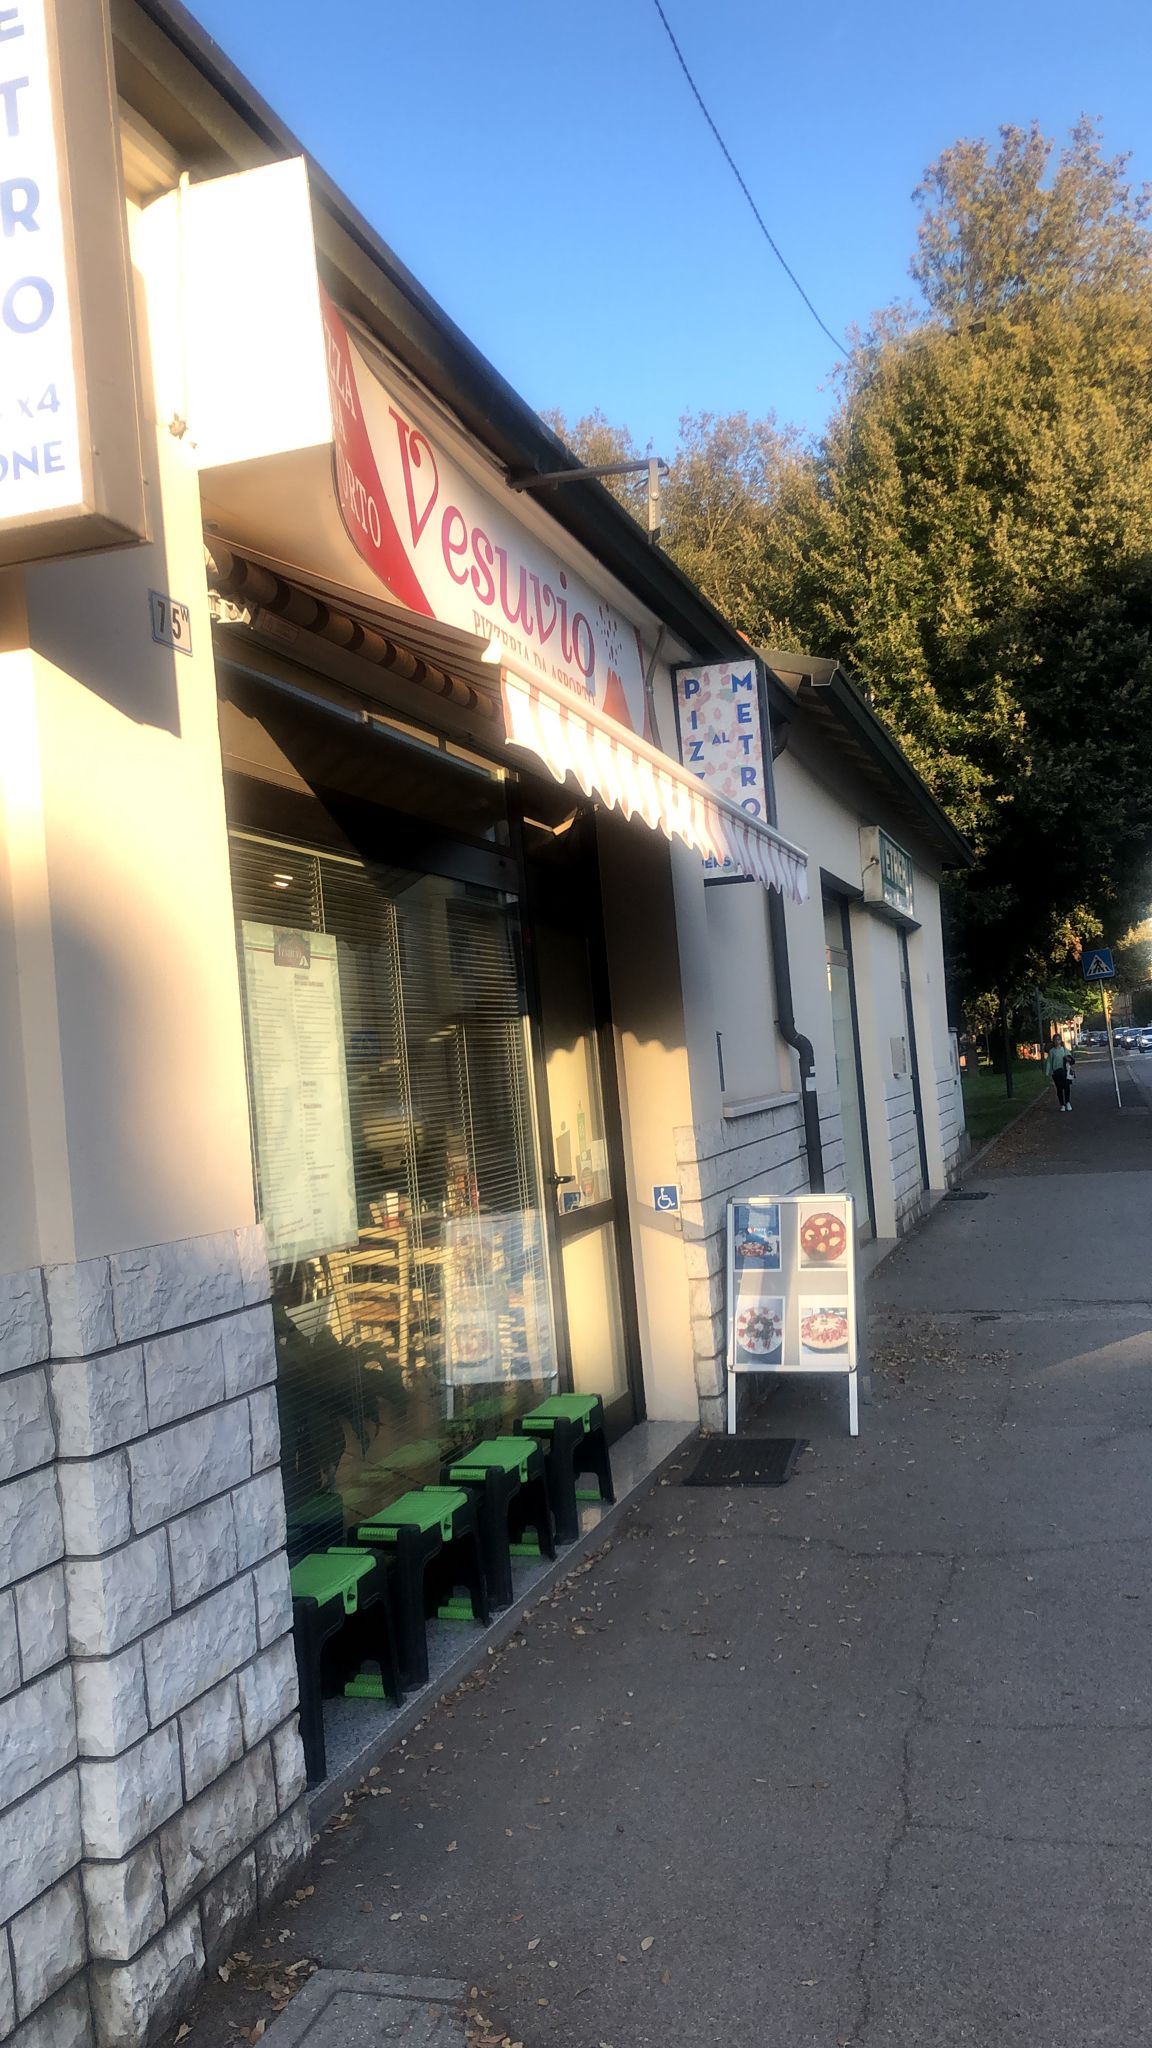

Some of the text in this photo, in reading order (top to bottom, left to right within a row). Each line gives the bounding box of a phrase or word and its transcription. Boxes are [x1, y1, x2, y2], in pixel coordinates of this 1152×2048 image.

[323, 319, 355, 420] ZZA
[388, 405, 596, 678] Vesuvio
[685, 680, 704, 779] PIZ
[712, 731, 730, 745] AL
[731, 671, 761, 817] METRO
